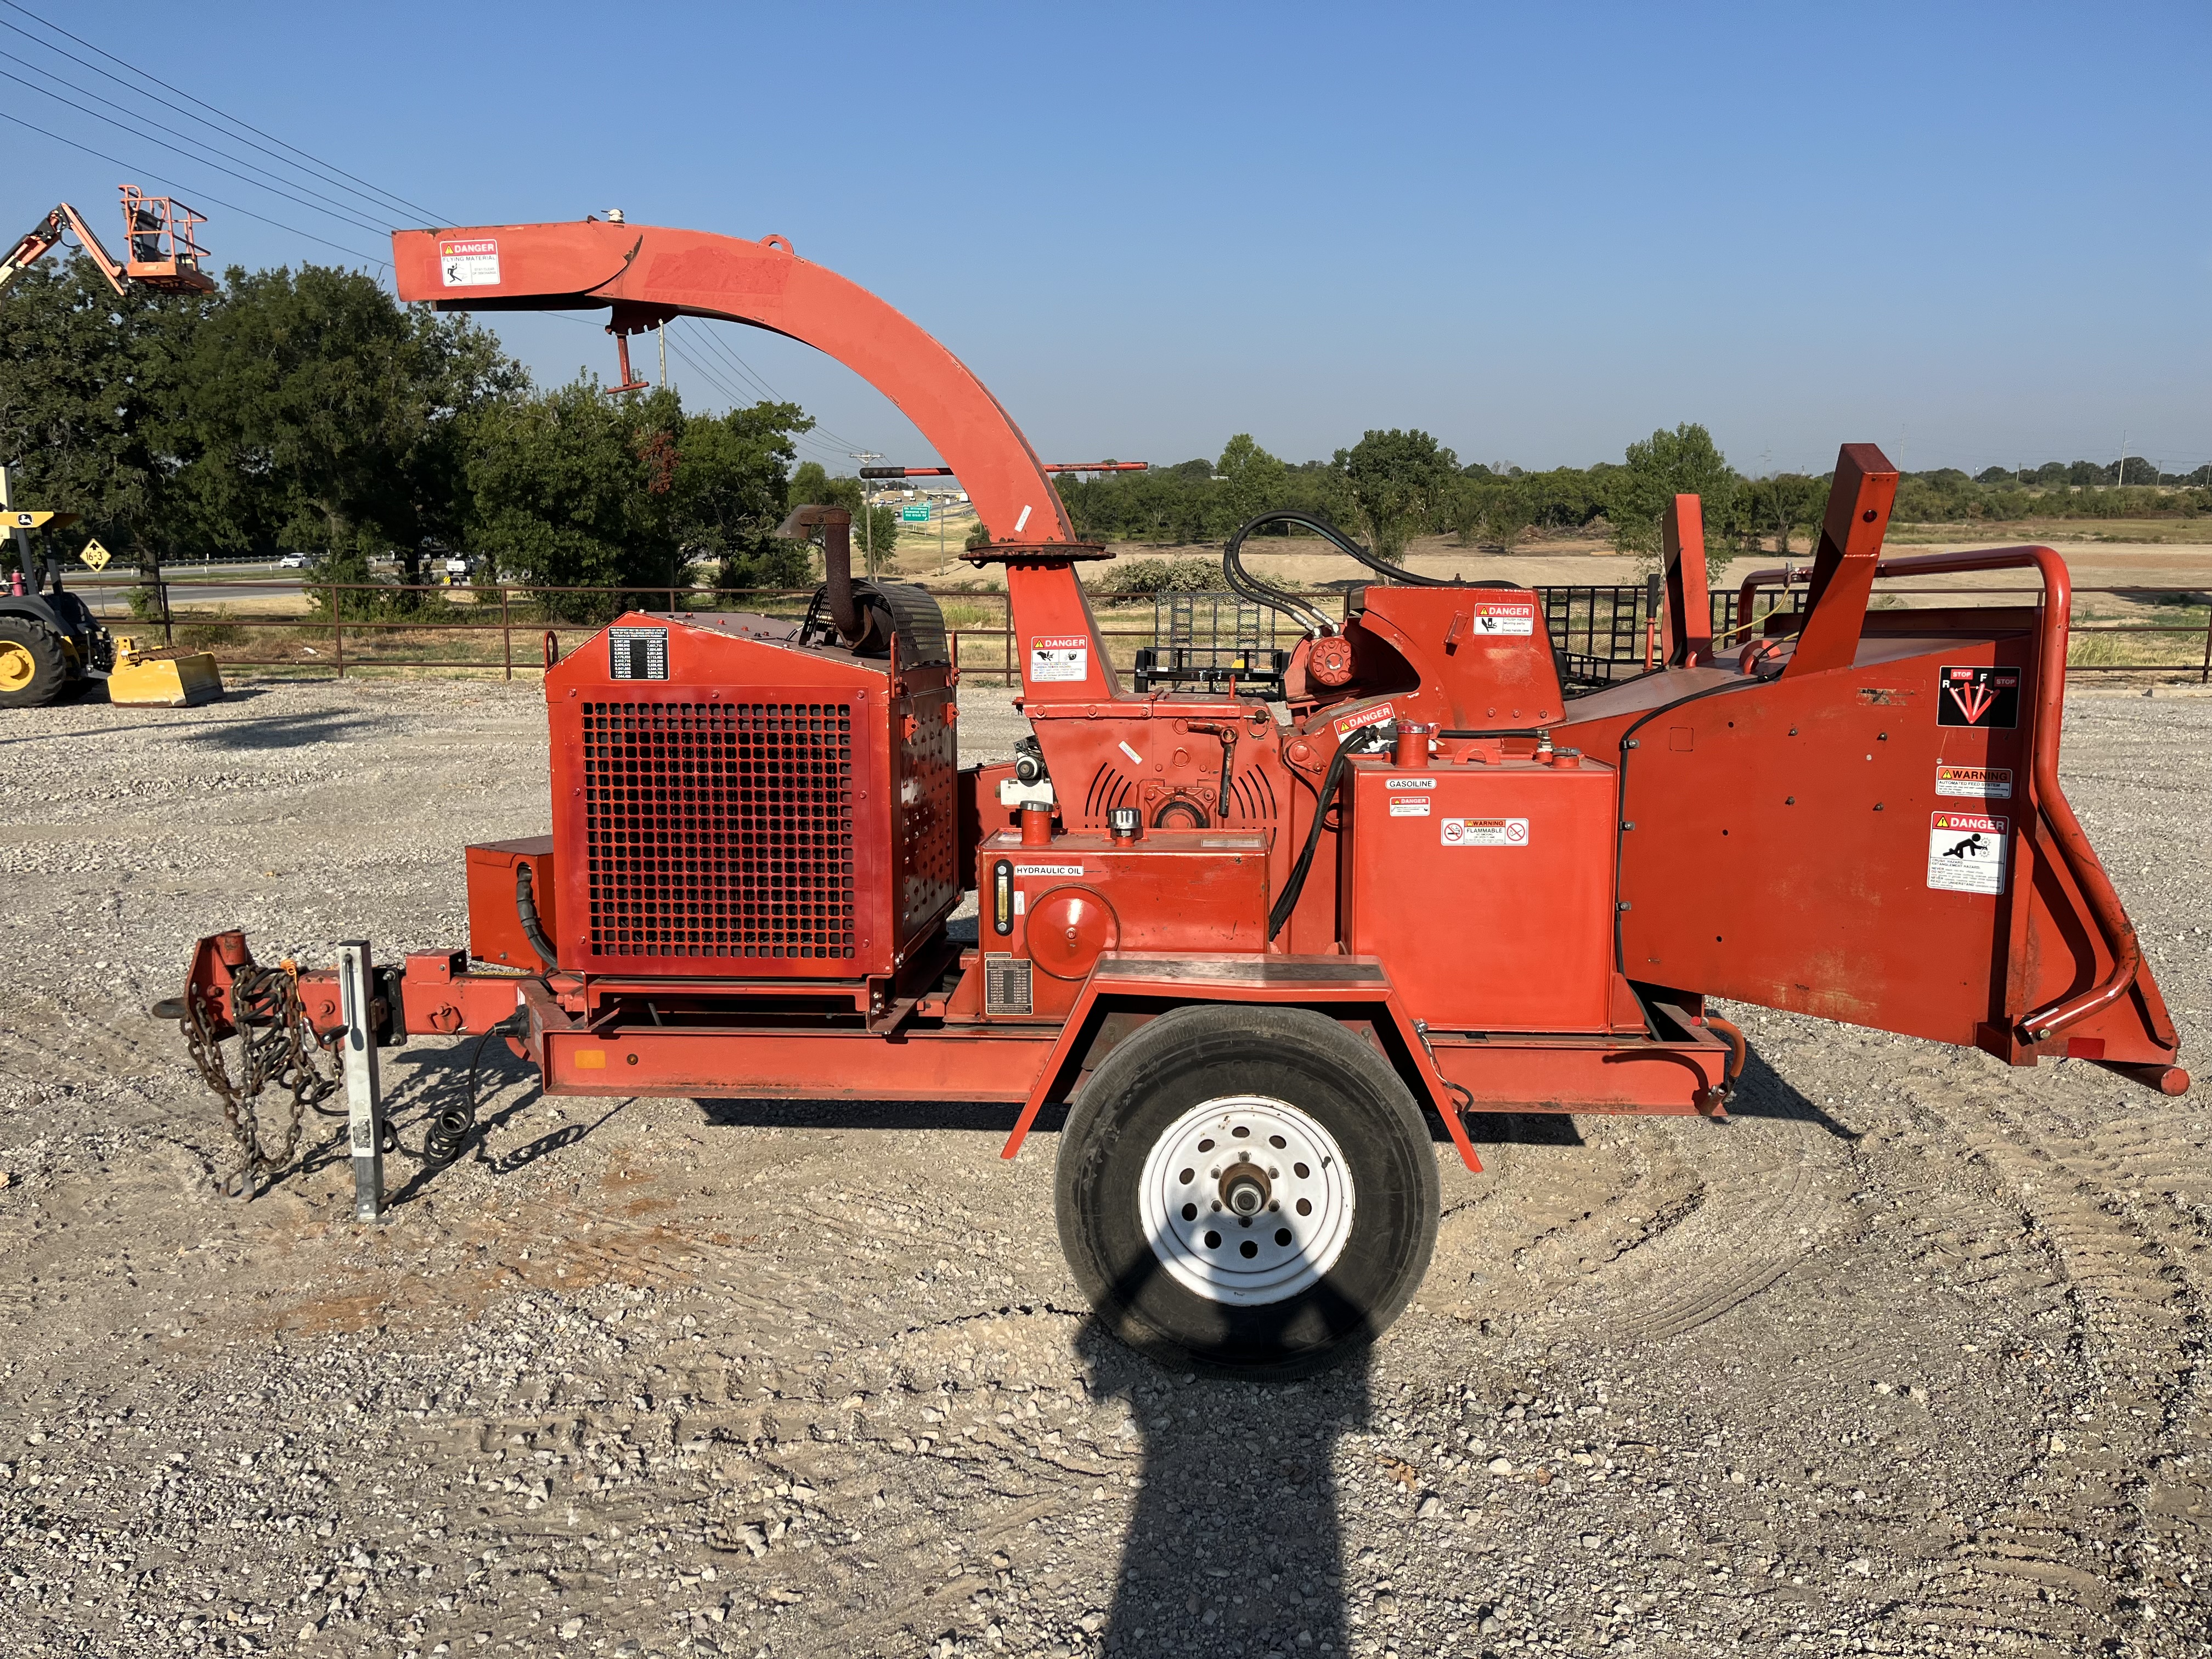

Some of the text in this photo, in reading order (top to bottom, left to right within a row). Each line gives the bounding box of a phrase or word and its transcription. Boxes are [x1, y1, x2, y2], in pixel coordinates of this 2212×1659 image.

[454, 244, 494, 253] DANGER
[1489, 607, 1529, 616] DANGER
[1045, 639, 1085, 647] DANGER
[1980, 673, 1988, 682] F
[1942, 680, 1950, 688] R
[1350, 707, 1391, 727] DANGER
[1953, 770, 2007, 781] WARNING
[1950, 817, 2005, 831] DANGER
